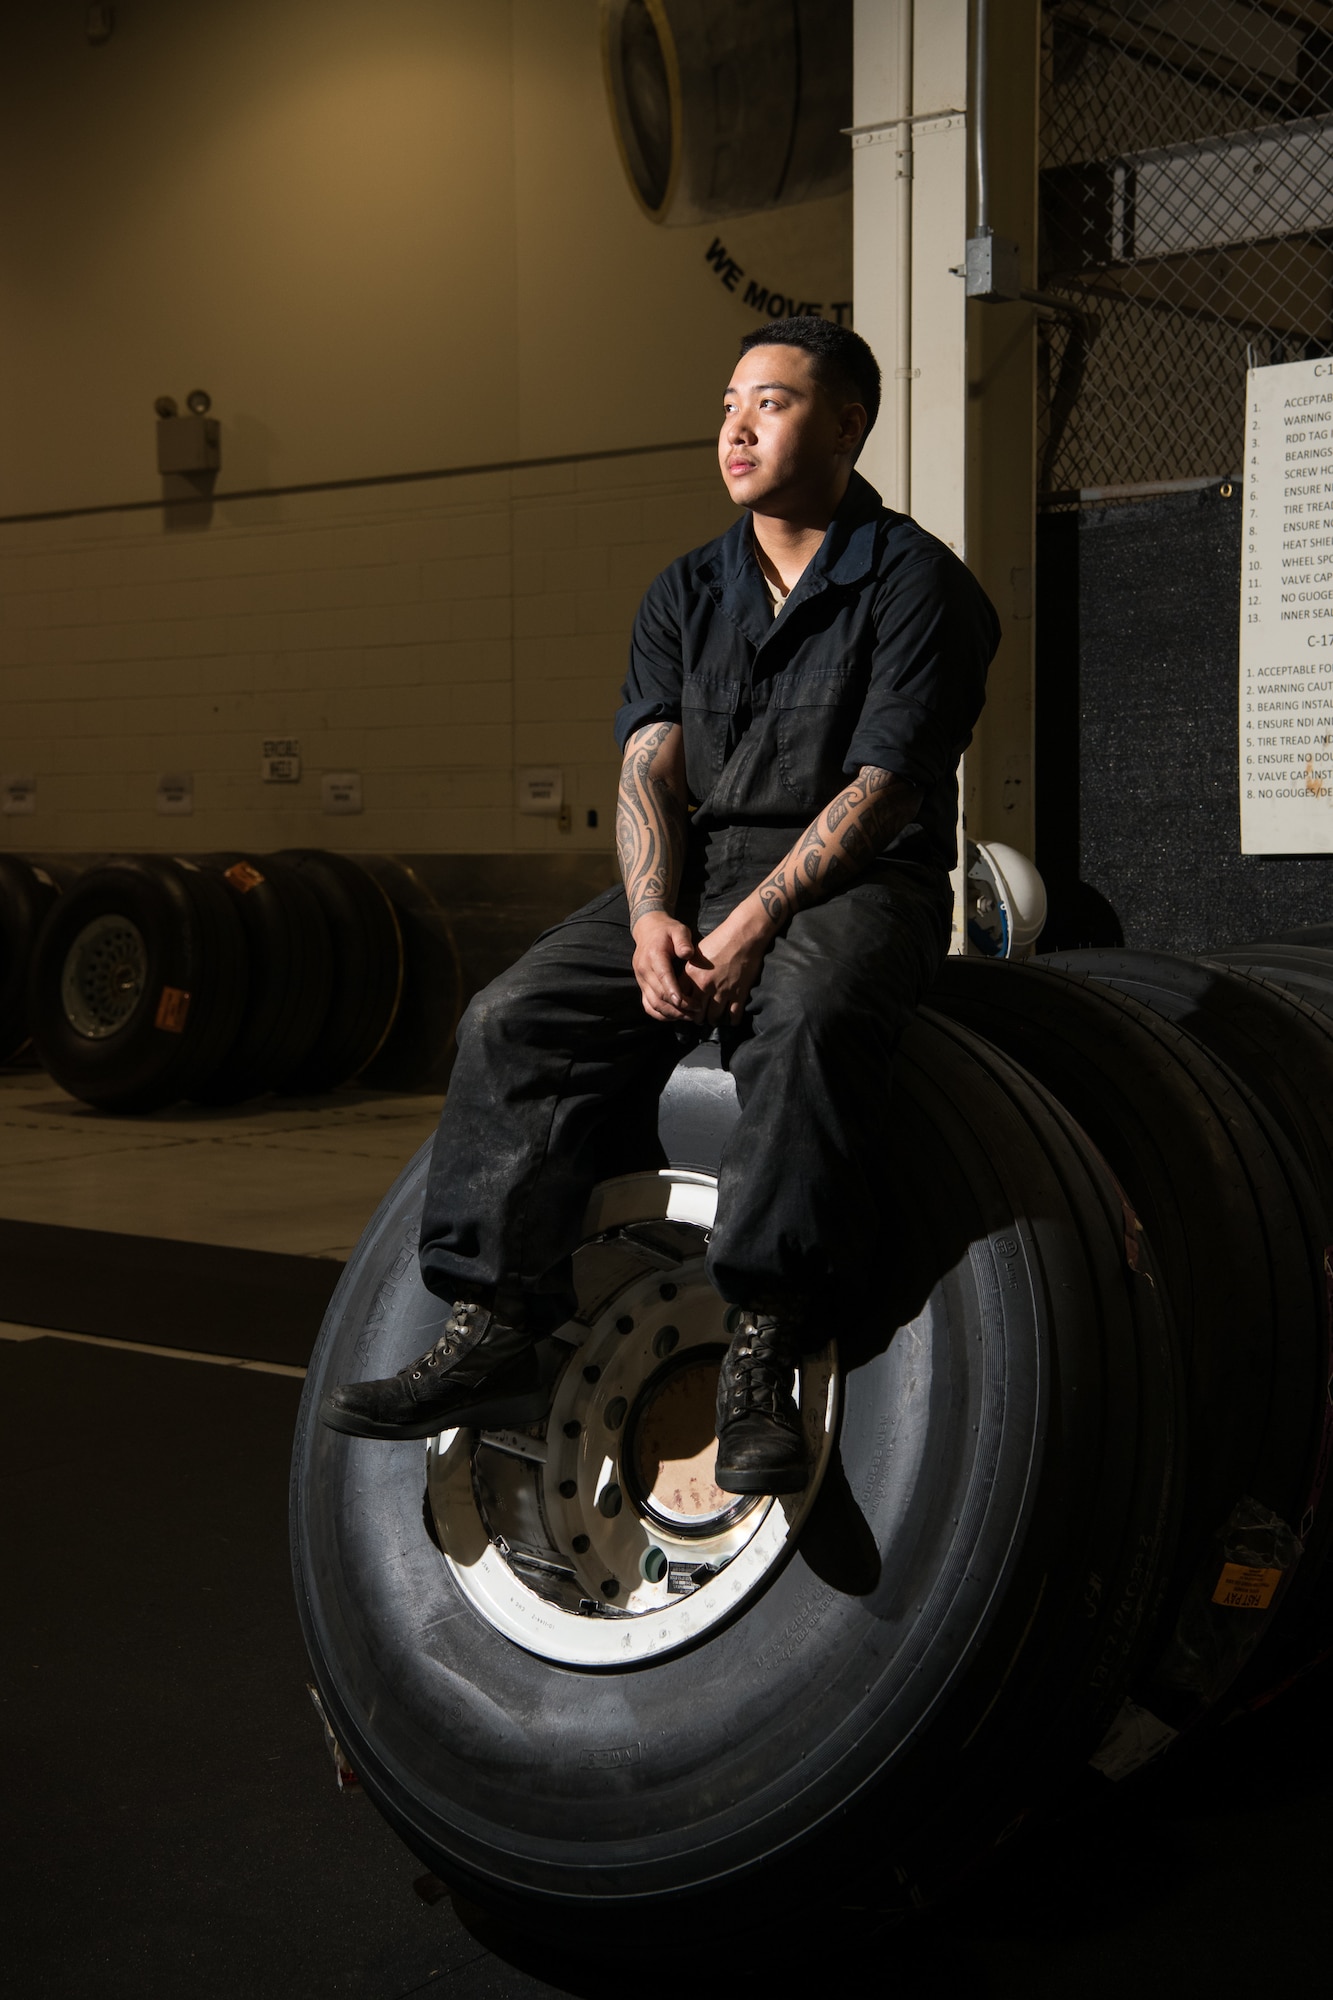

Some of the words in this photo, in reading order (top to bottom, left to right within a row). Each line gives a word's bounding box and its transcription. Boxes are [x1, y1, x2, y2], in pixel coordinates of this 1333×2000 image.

[705, 237, 744, 292] WE
[743, 280, 823, 319] MOVE
[831, 301, 853, 324] T
[1253, 403, 1261, 413] 1.
[1284, 393, 1333, 408] ACCEPTAB
[1252, 421, 1261, 431] 2.
[1284, 411, 1332, 426] WARNING
[1252, 438, 1260, 448] 3.
[1309, 430, 1328, 441] TAG
[1251, 456, 1259, 465] 4.
[1285, 447, 1333, 462] BEARINGS
[1251, 474, 1259, 483] 5.
[1284, 466, 1318, 479] SCREW
[1250, 492, 1258, 501] 6.
[1284, 484, 1321, 497] ENSURE
[1324, 483, 1333, 493] N
[1250, 509, 1258, 518] 7.
[1284, 504, 1304, 515] TIRE
[1249, 526, 1258, 536] 8.
[1283, 520, 1320, 533] ENSURE
[1249, 544, 1257, 554] 9.
[1283, 538, 1307, 550] HEAT
[1249, 562, 1262, 571] 10.
[1282, 556, 1314, 568] WHEEL
[1248, 579, 1262, 588] 11.
[1281, 574, 1311, 586] VALVE
[1314, 572, 1333, 583] CAP
[1248, 596, 1261, 606] 12.
[1281, 593, 1296, 603] NO
[1247, 613, 1261, 623] 13.
[1281, 610, 1310, 621] INNER
[1312, 608, 1333, 618] SEAL
[1247, 669, 1255, 678] 1.
[1257, 664, 1316, 677] ACCEPTABLE
[1246, 686, 1255, 695] 2.
[1257, 683, 1305, 694] WARNING
[1307, 681, 1333, 692] CAUT
[1246, 704, 1255, 712] 3.
[1257, 701, 1299, 712] BEARING
[1302, 699, 1333, 710] INSTAL
[1246, 720, 1255, 729] 4.
[1257, 719, 1294, 729] ENSURE
[1297, 718, 1314, 728] NDI
[1246, 738, 1255, 747] 5.
[1257, 737, 1277, 747] TIRE
[1280, 736, 1311, 746] TREAD
[1314, 734, 1333, 744] AND
[1246, 755, 1255, 764] 6.
[1258, 754, 1294, 764] ENSURE
[1297, 753, 1312, 762] NO
[1247, 773, 1255, 782] 7.
[1257, 771, 1287, 781] VALVE
[1290, 770, 1309, 780] CAP
[1311, 770, 1333, 780] INST
[1247, 790, 1255, 799] 8.
[1258, 789, 1273, 799] NO
[1276, 787, 1333, 800] GOUGES/DE
[1223, 1592, 1243, 1606] PAY
[1240, 1594, 1261, 1606] FAST
